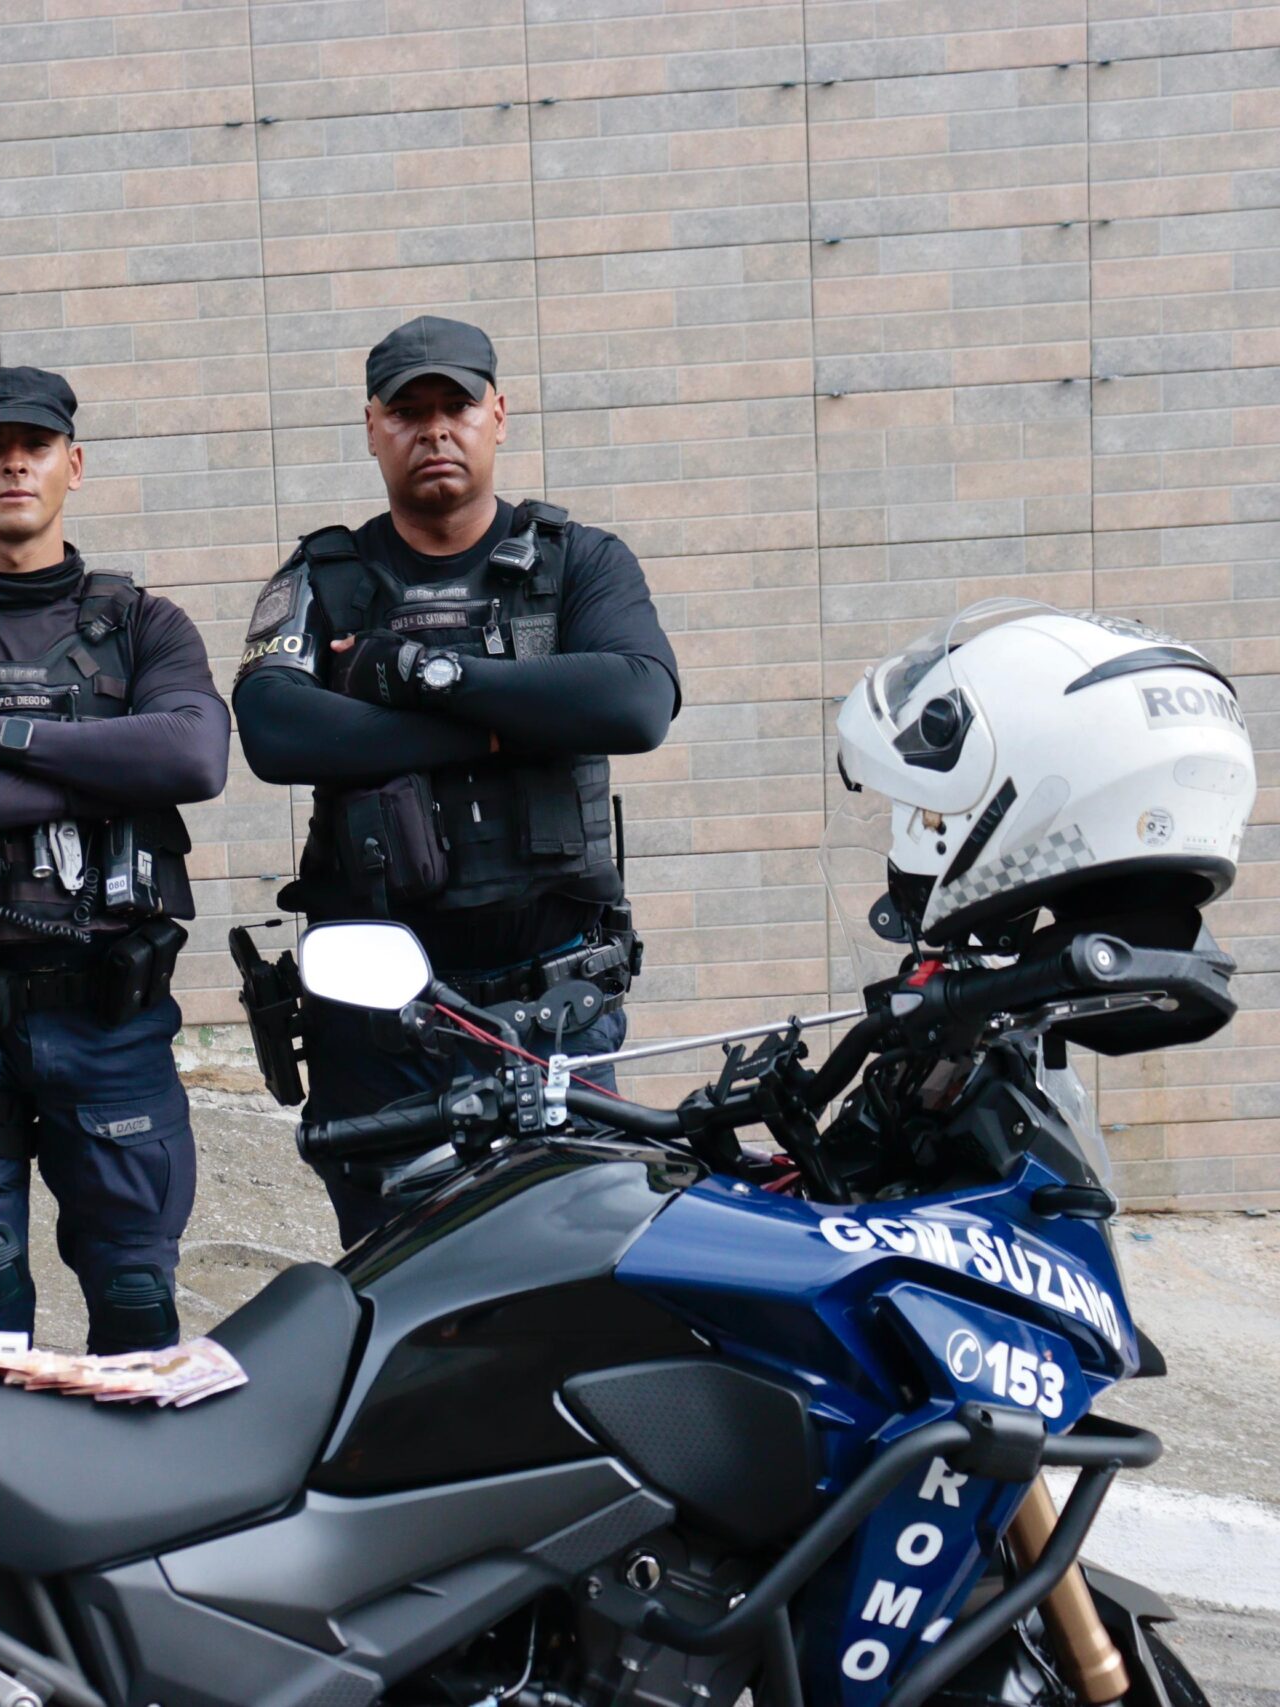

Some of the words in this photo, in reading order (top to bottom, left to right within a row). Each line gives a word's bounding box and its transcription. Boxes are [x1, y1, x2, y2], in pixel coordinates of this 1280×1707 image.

[17, 695, 40, 706] DIEGO
[819, 1216, 960, 1269] GCM
[966, 1227, 1122, 1350] SUZANO
[984, 1340, 1065, 1418] 153
[841, 1456, 969, 1682] ROMO
